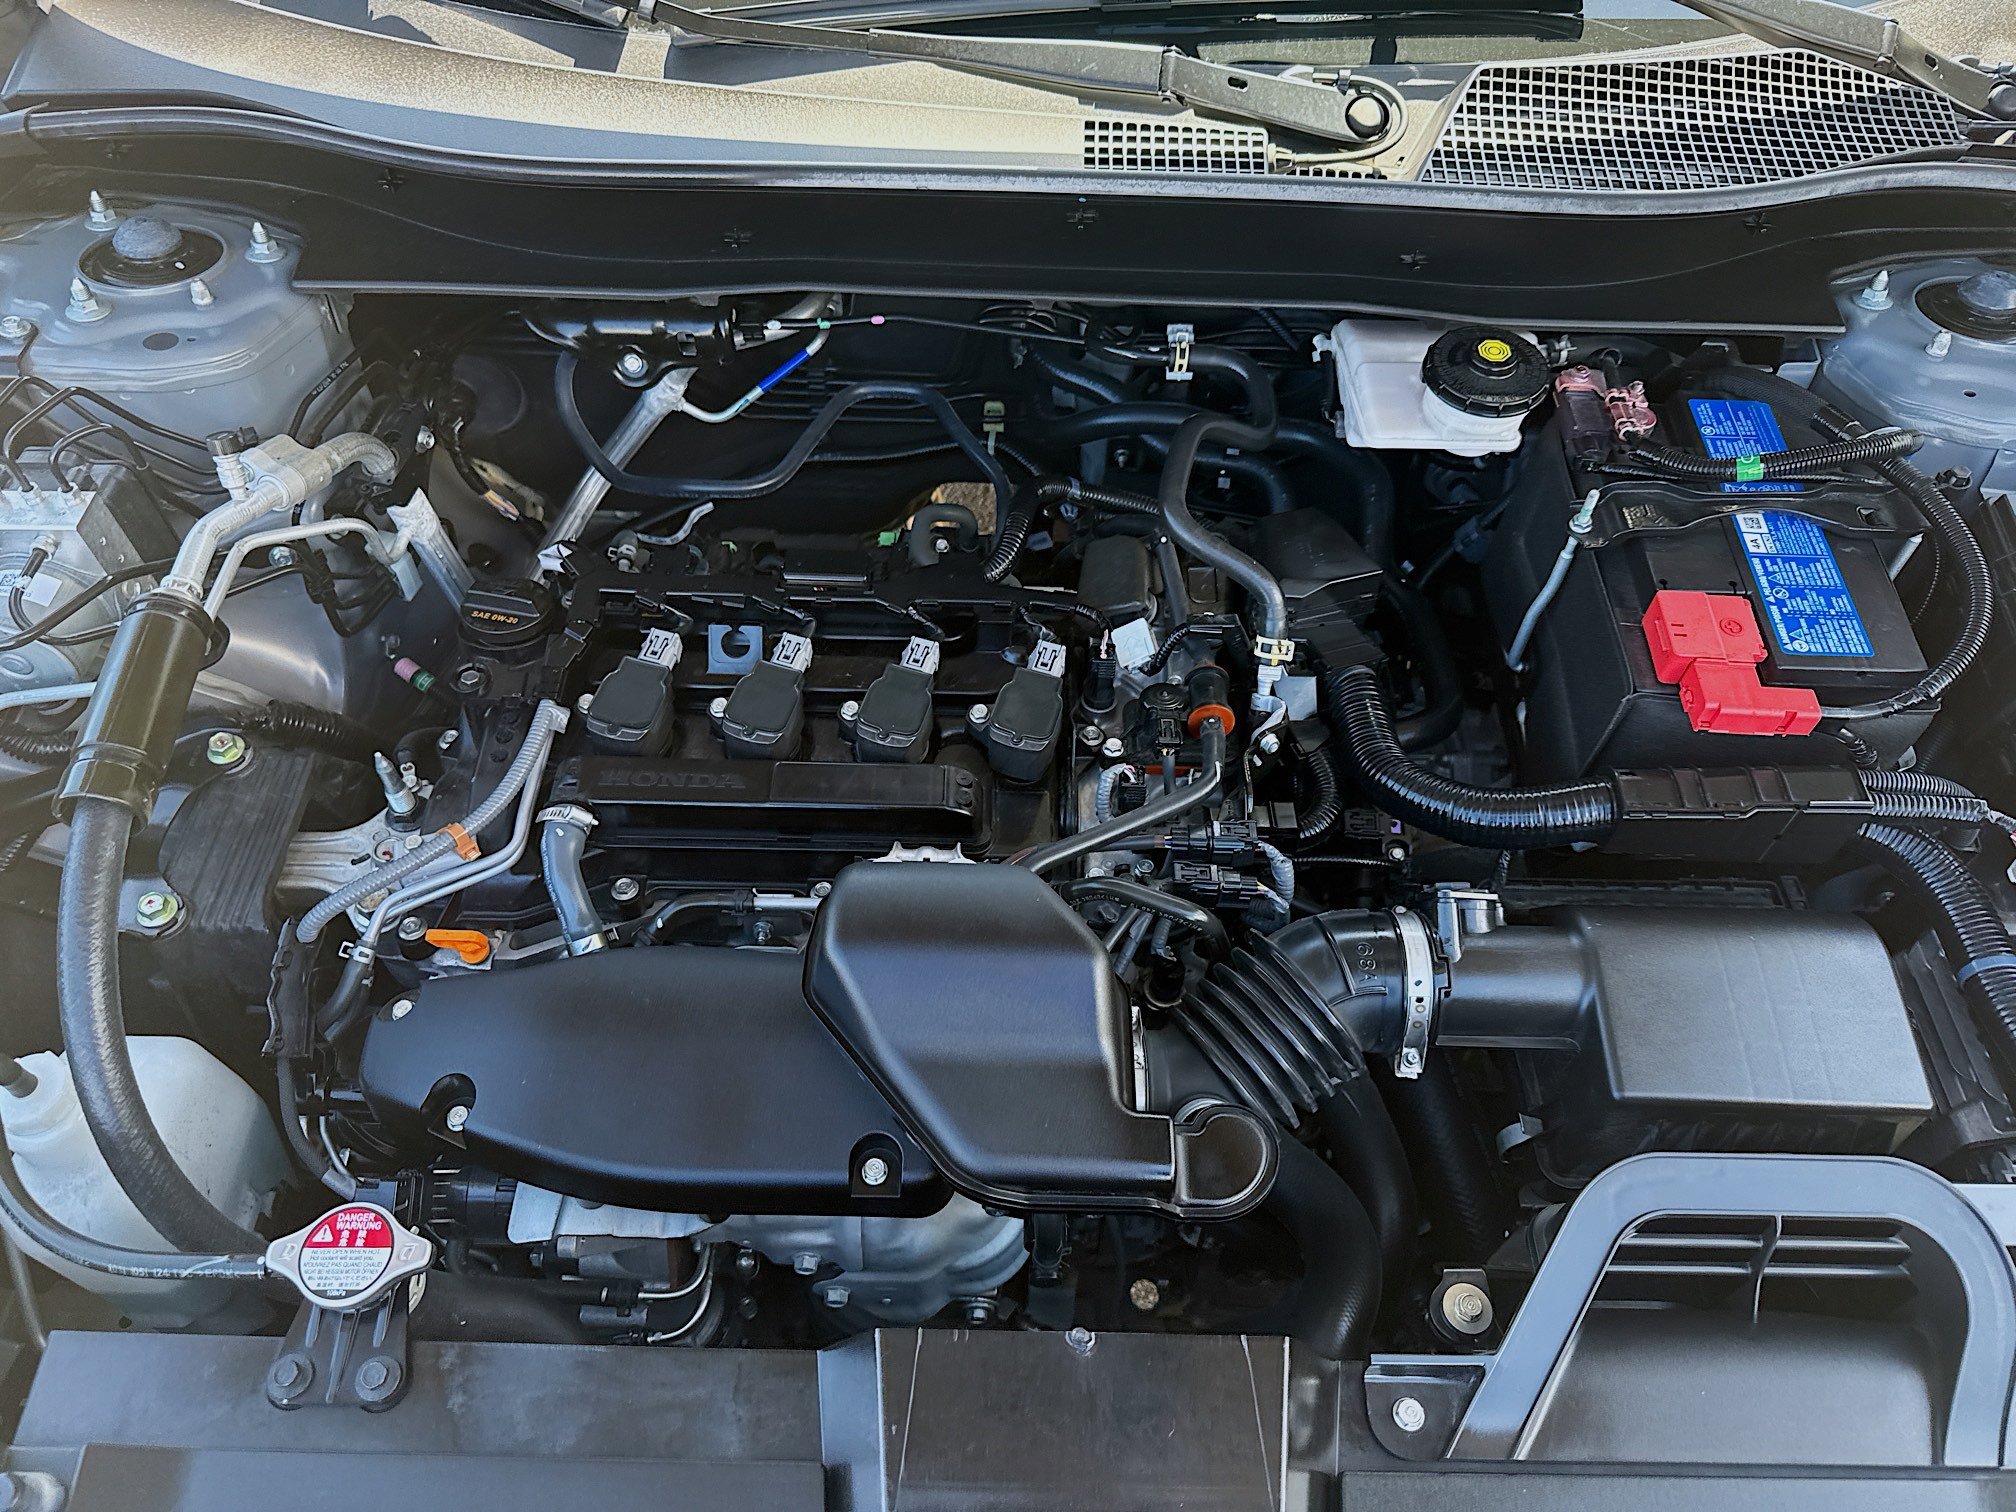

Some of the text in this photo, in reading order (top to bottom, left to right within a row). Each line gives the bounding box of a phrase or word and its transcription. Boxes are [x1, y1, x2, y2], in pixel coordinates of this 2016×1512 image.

[1749, 538, 1761, 548] 4A
[471, 610, 518, 624] SAE 0W-20
[598, 768, 746, 789] HONDA
[337, 1212, 376, 1222] DANGER
[336, 1221, 382, 1230] WARNUNG
